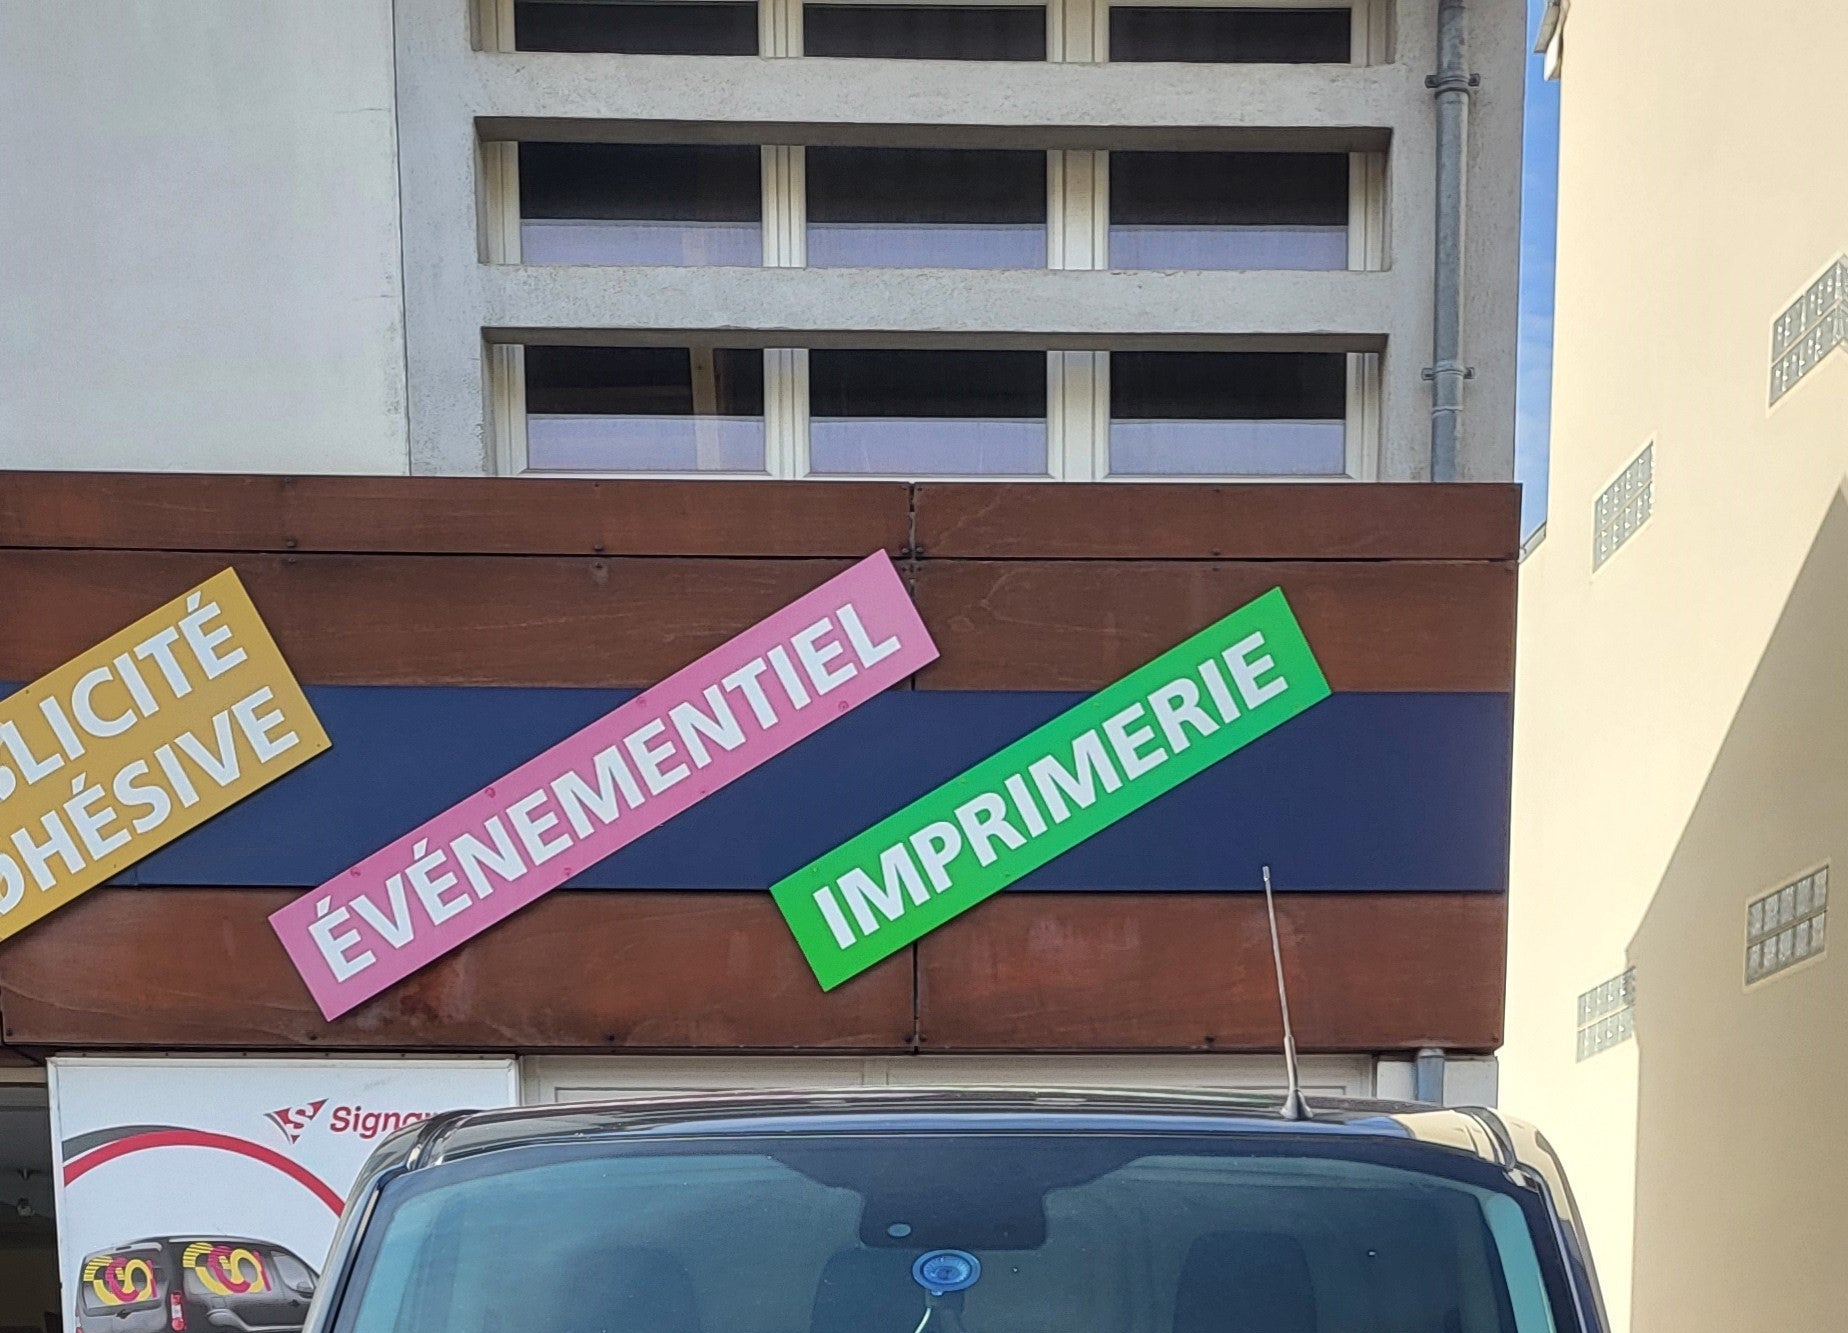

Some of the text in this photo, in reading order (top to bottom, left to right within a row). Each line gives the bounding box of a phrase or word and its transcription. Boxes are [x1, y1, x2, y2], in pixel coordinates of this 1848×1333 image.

[0, 590, 248, 801] LICITÉ
[307, 603, 901, 983] ÉVÉNEMENTIEL
[812, 631, 1290, 950] IMPRIMERIE
